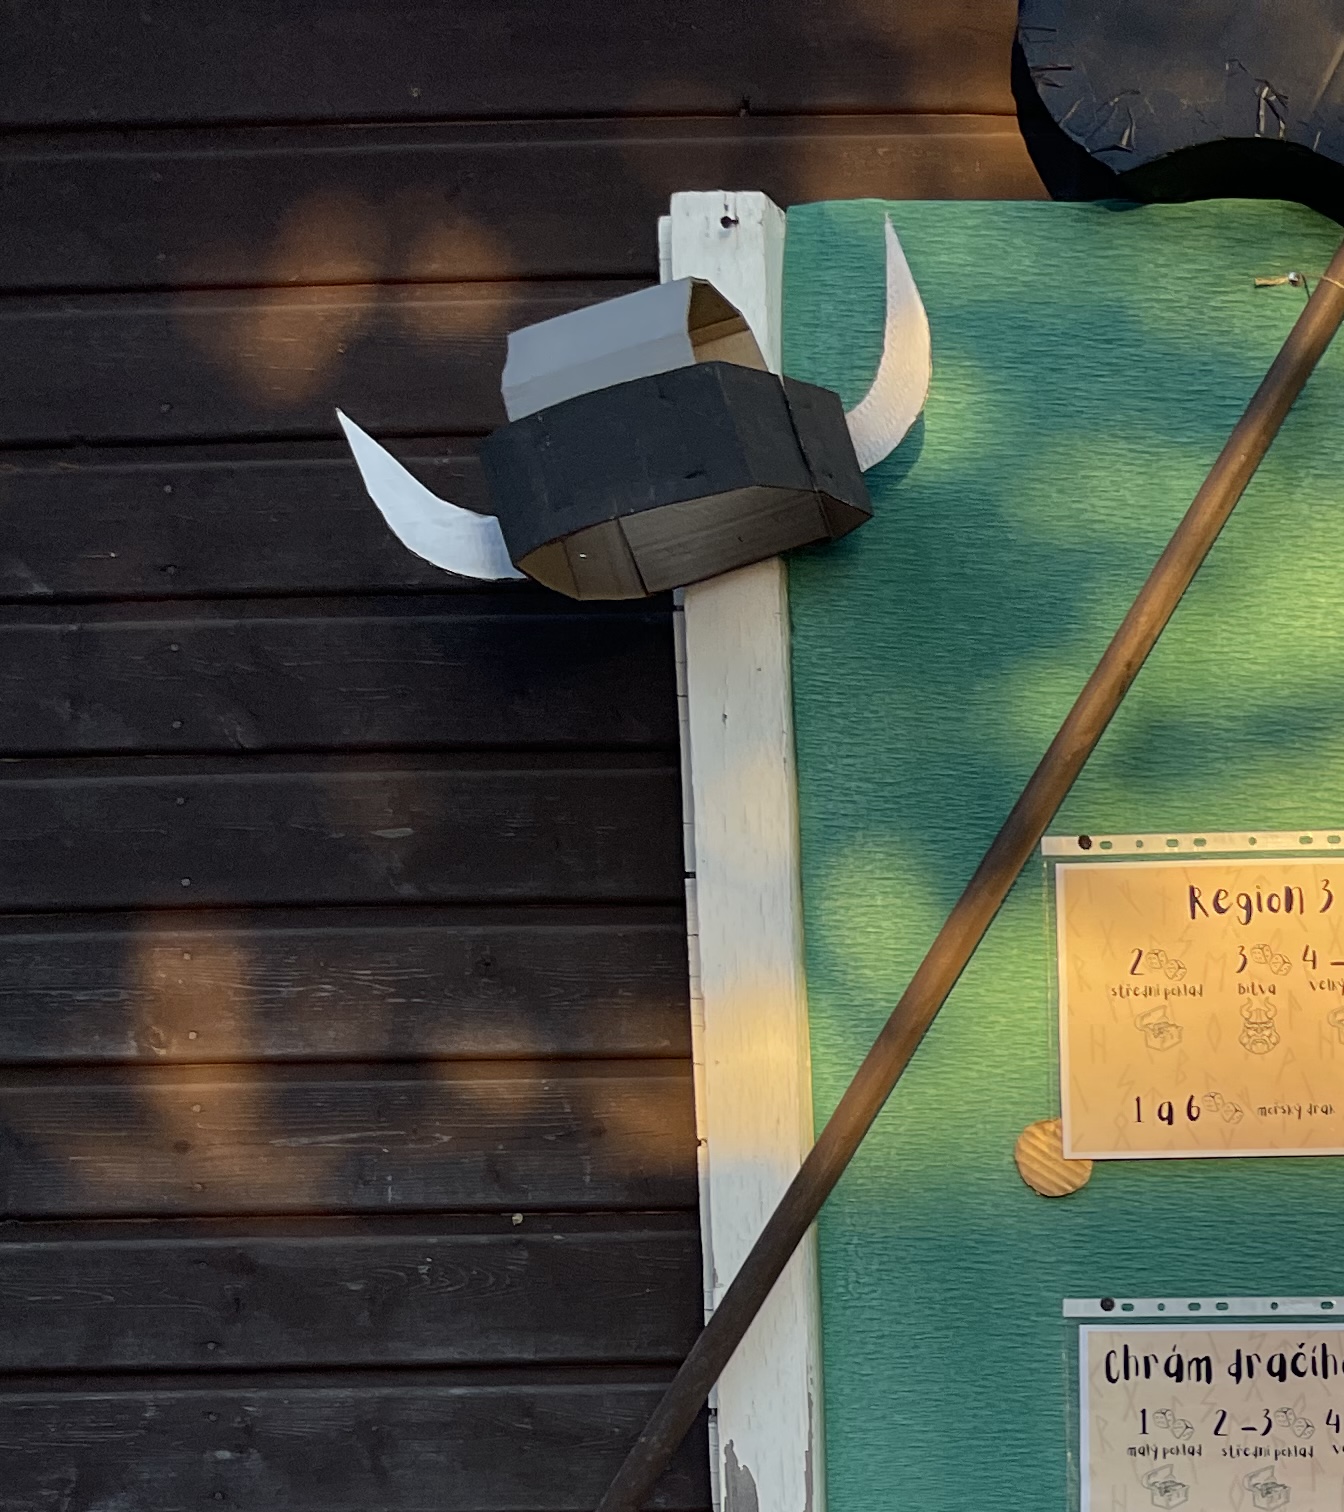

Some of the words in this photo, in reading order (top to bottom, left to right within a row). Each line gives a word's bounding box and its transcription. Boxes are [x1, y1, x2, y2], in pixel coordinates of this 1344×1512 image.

[1189, 884, 1304, 925] Region
[1320, 879, 1334, 913] 3
[1130, 948, 1145, 976] 2
[1235, 945, 1248, 974] 3
[1302, 944, 1317, 970] 4
[1111, 982, 1161, 999] střední
[1164, 983, 1204, 1000] poklad
[1238, 982, 1277, 996] bitva
[1134, 1096, 1145, 1123] 1
[1157, 1101, 1174, 1125] a
[1186, 1095, 1201, 1121] 6
[1306, 1102, 1336, 1116] drak
[1104, 1344, 1212, 1385] Chrám
[1138, 1408, 1149, 1435] 1
[1213, 1409, 1228, 1436] 2
[1260, 1408, 1273, 1436] 3
[1325, 1409, 1340, 1433] 4
[1162, 1444, 1203, 1459] poklad
[1221, 1444, 1270, 1459] střední
[1274, 1445, 1314, 1461] poklad
